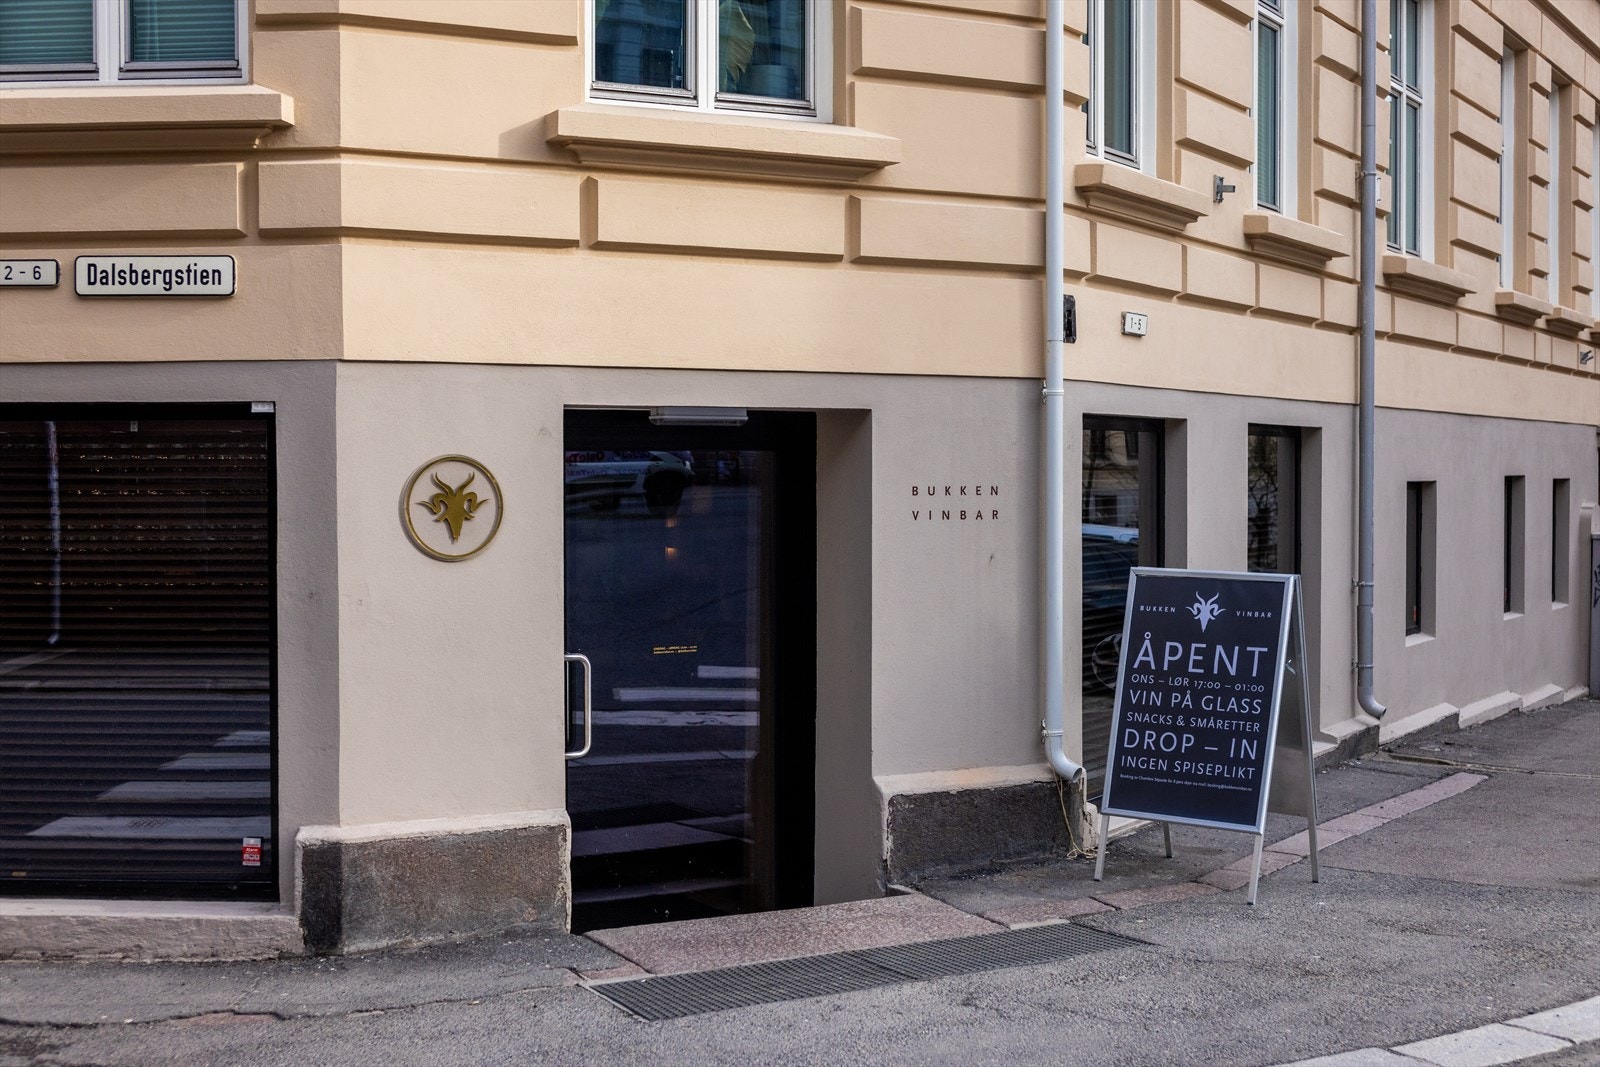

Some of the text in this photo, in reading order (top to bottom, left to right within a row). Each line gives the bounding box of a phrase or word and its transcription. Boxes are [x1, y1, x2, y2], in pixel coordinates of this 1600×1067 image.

[4, 266, 13, 280] 2
[33, 266, 42, 280] 6
[87, 263, 222, 292] Dalsbergstien
[912, 485, 999, 496] BUKKEN
[912, 510, 999, 521] VINBAR
[1139, 605, 1272, 618] BUKKEN VINBAR
[1133, 631, 1268, 677] ÅPENT
[1131, 673, 1154, 684] ONS
[1168, 677, 1190, 687] LØR
[1194, 680, 1221, 690] 17:00
[1235, 683, 1265, 693] 01:00
[1129, 689, 1262, 715] VIN PÅ GLASS
[1126, 711, 1260, 732] SNACKS & SMÅRETTER
[1123, 728, 1195, 753] DROP
[1230, 737, 1258, 761] IN
[1121, 755, 1256, 780] INGEN SPISEPLIKT
